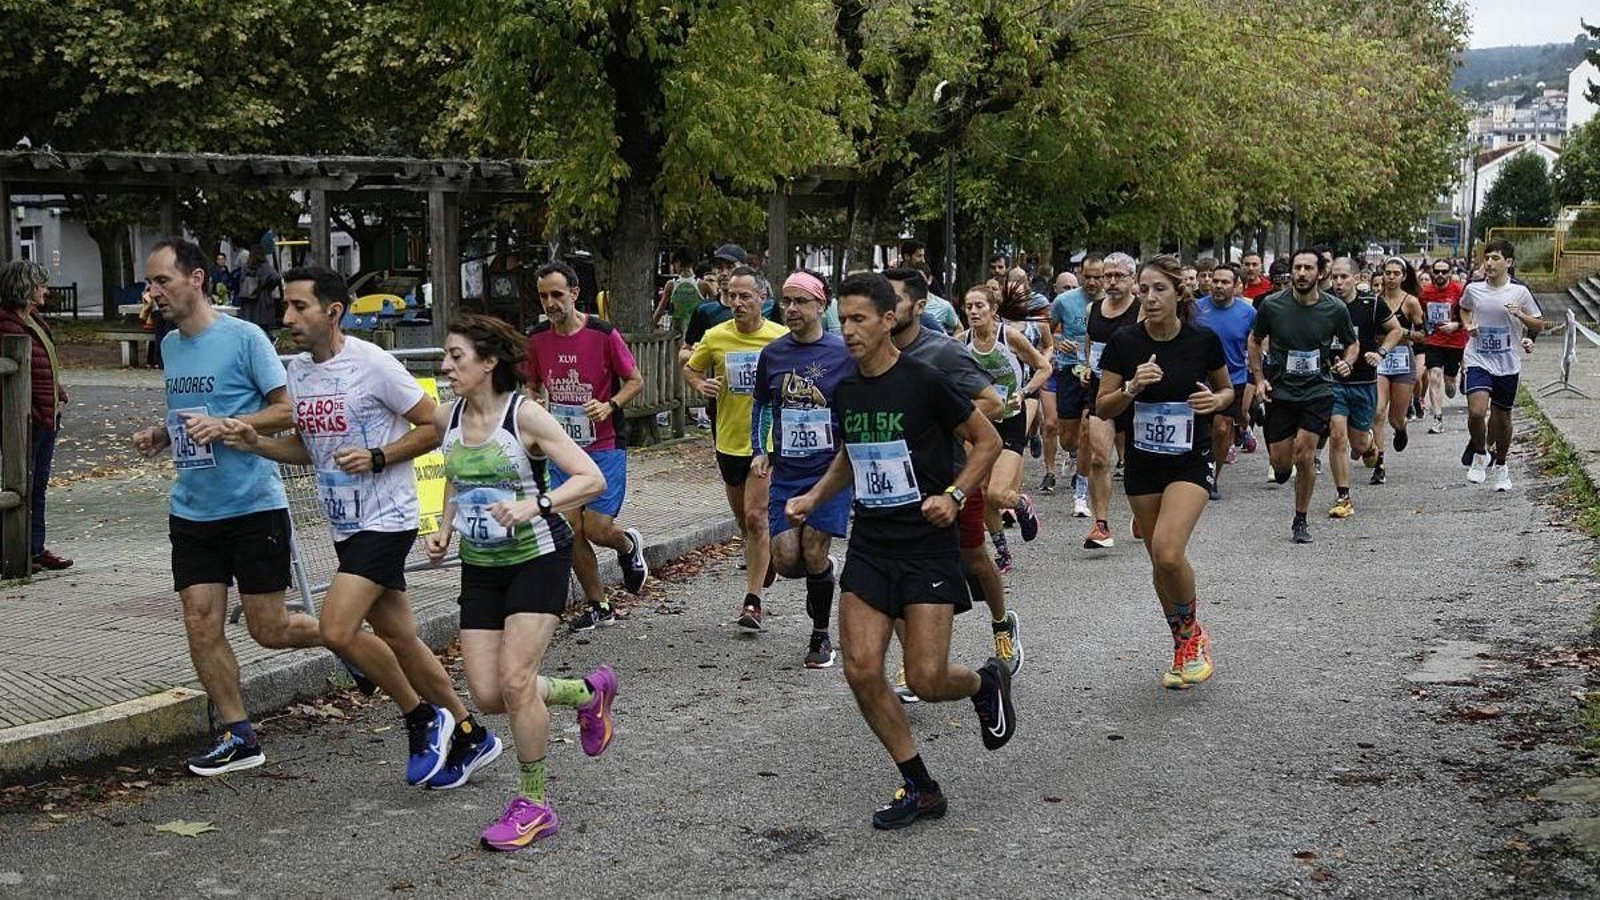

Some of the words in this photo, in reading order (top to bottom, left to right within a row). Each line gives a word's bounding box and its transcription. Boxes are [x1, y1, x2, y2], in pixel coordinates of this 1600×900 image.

[558, 355, 577, 364] XLVI
[297, 400, 334, 417] CABO
[334, 402, 344, 410] DE
[298, 416, 348, 434] PEÑAS
[876, 411, 905, 432] 5K
[561, 424, 582, 439] 08
[791, 430, 818, 448] 293
[1145, 423, 1176, 444] 582
[174, 436, 196, 458] 245
[866, 472, 893, 495] 184
[467, 517, 489, 540] 75
